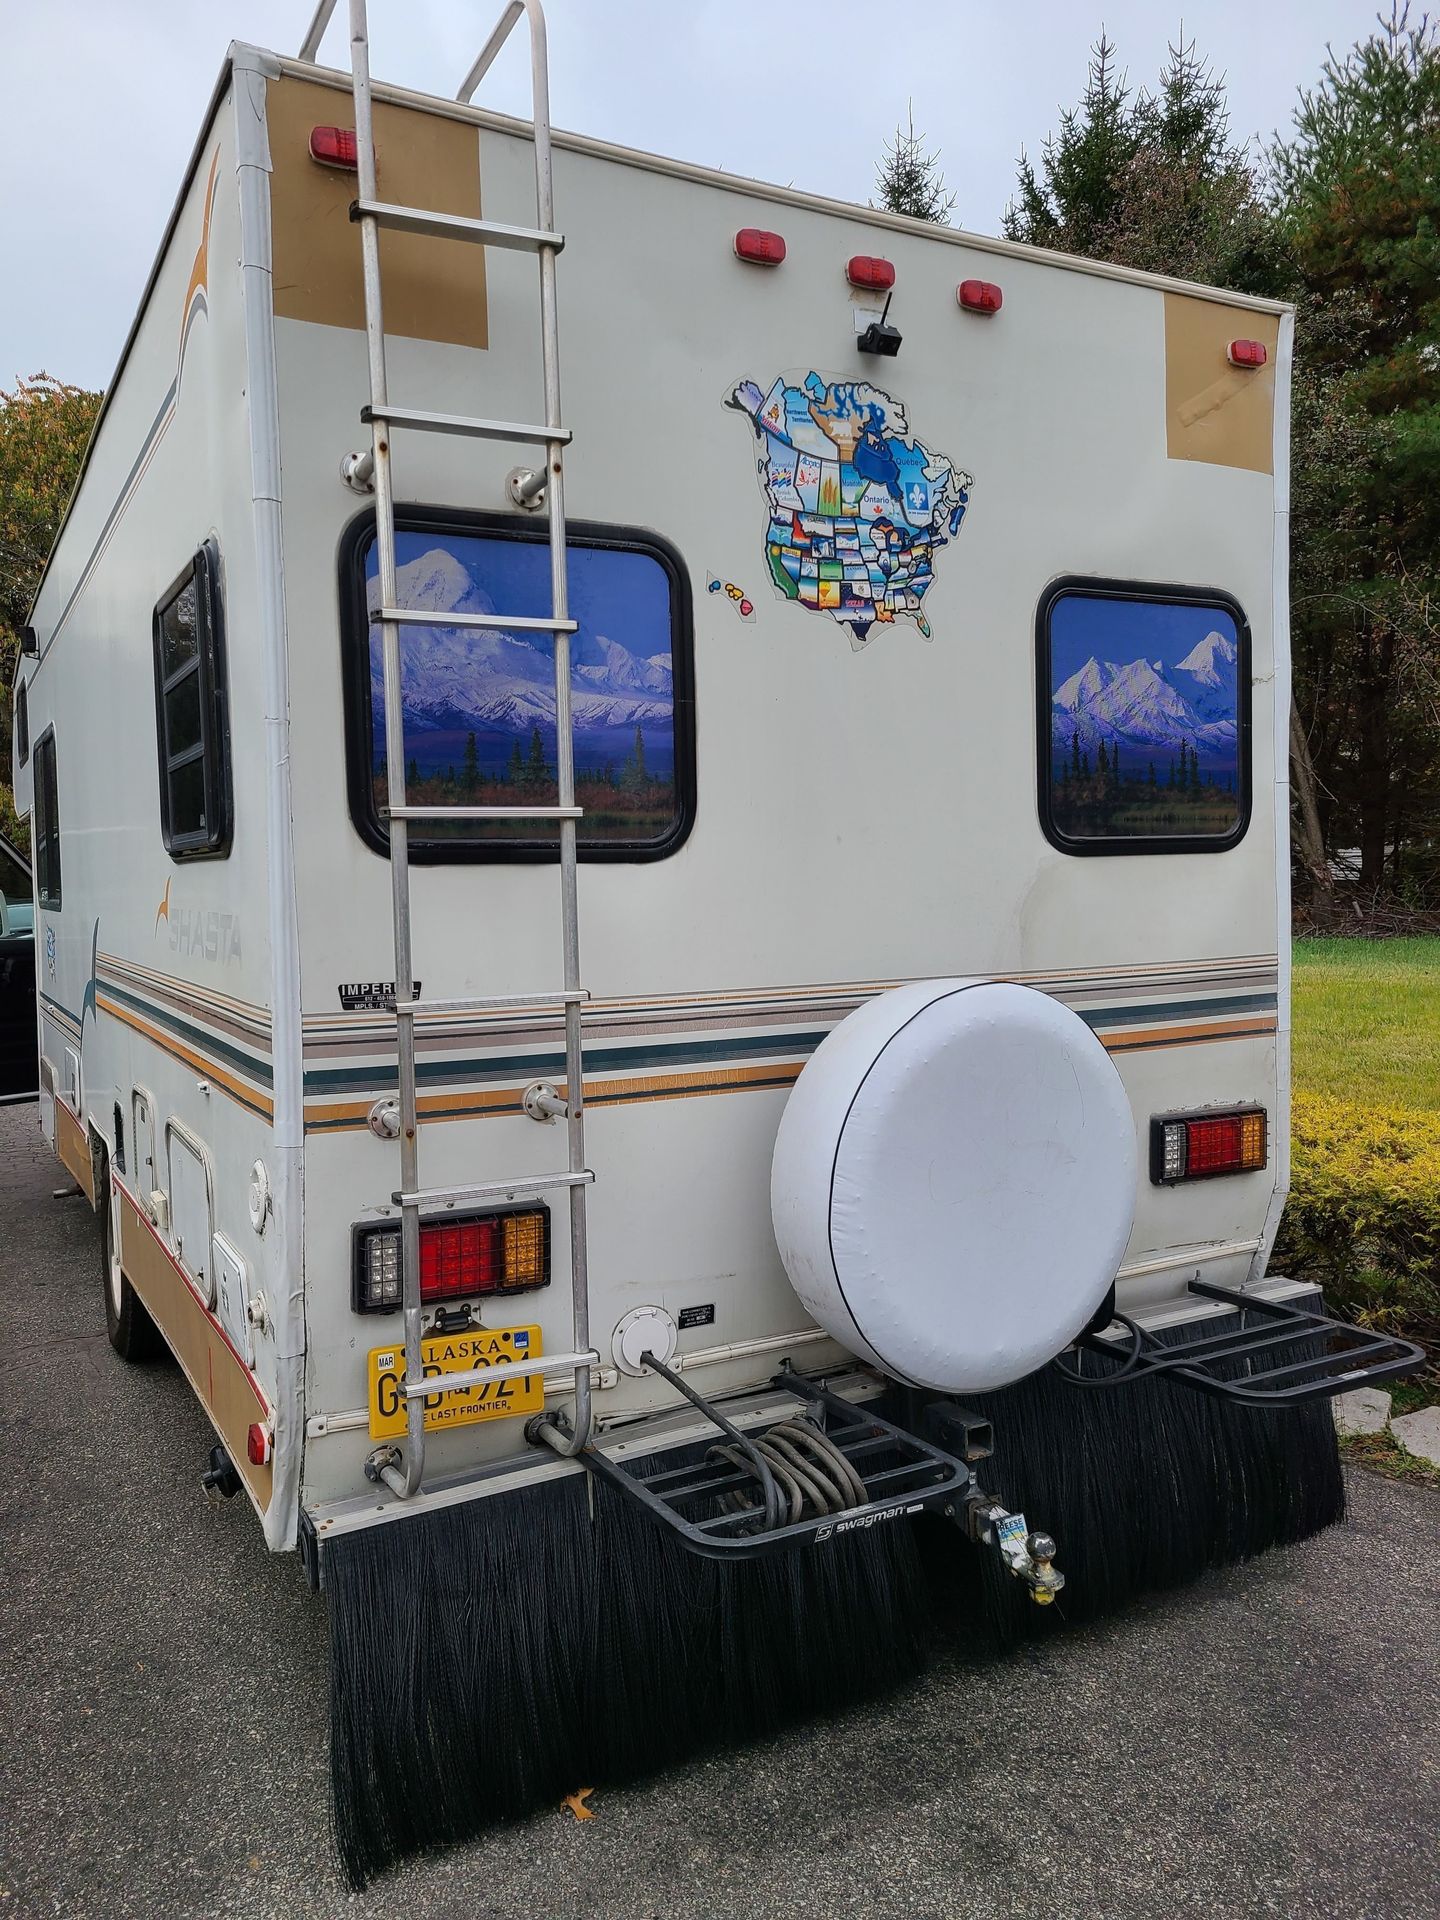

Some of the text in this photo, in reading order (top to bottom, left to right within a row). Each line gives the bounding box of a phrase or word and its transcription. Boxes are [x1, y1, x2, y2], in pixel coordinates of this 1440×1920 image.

[761, 415, 781, 434] Yukon
[895, 457, 923, 466] Québec
[863, 495, 890, 504] Ontario
[168, 907, 242, 970] SHASTA
[341, 983, 419, 996] IMPERL
[421, 1338, 501, 1364] LASKA
[379, 1356, 394, 1368] MAR
[431, 1408, 457, 1421] LAST
[460, 1400, 507, 1415] FRONTIER
[836, 1506, 904, 1533] swagman
